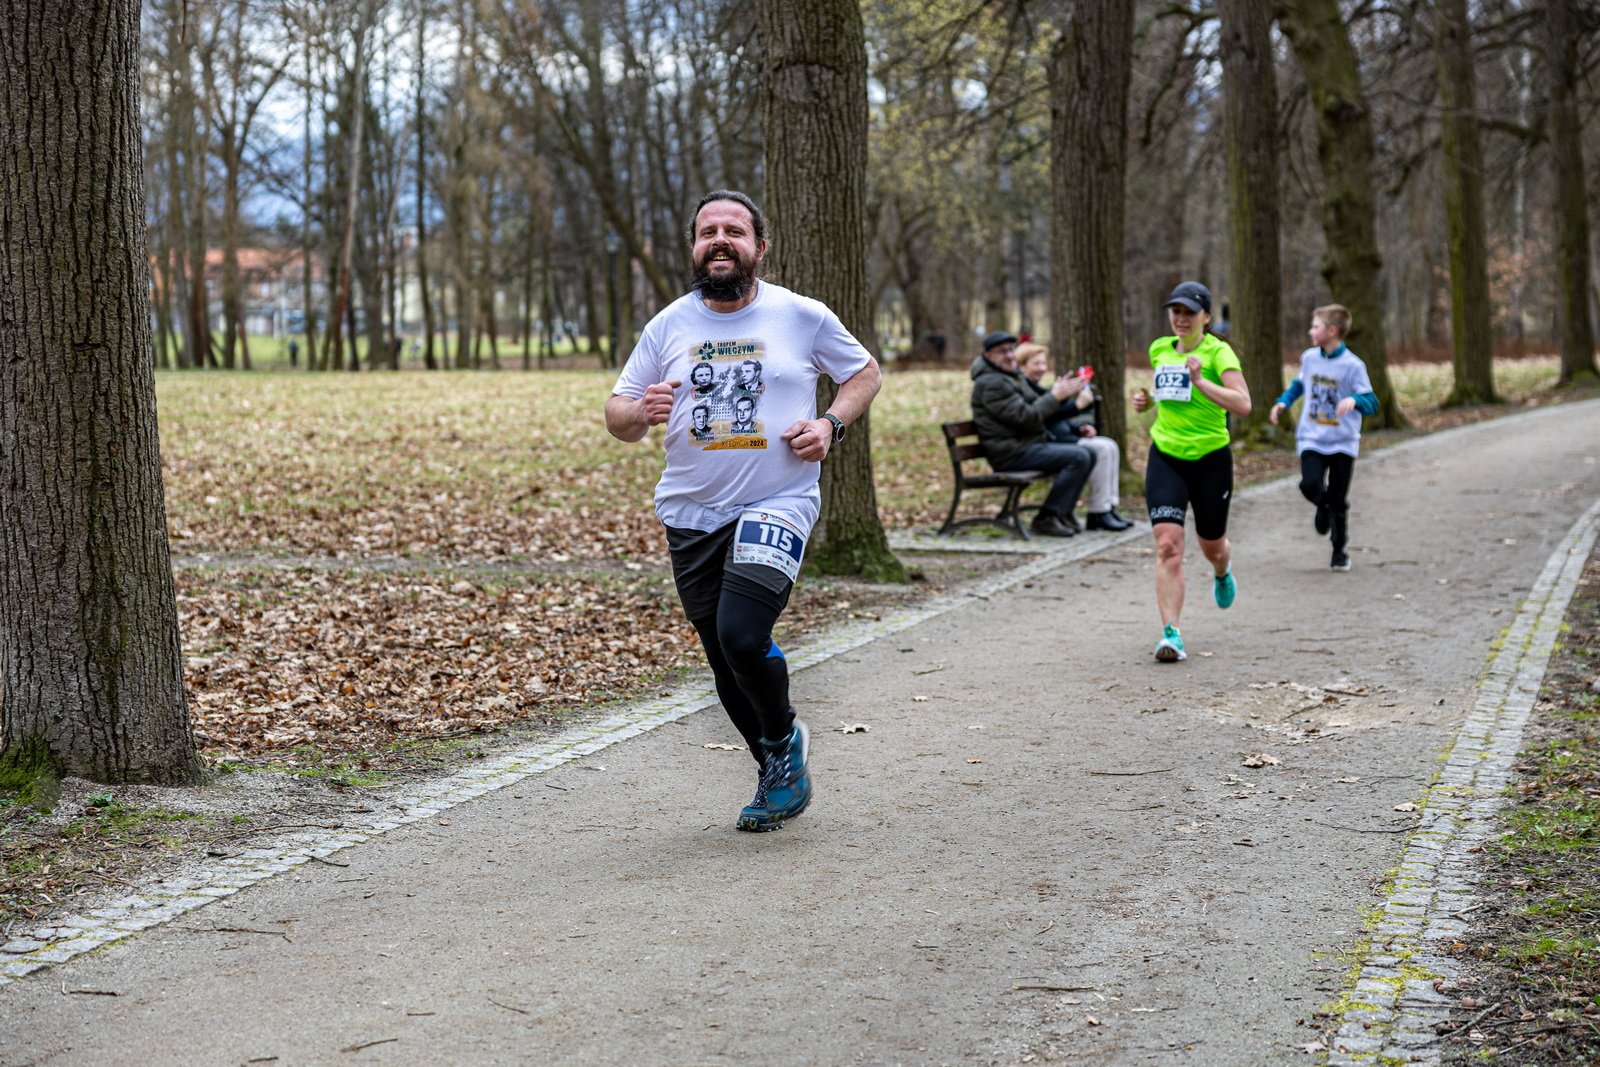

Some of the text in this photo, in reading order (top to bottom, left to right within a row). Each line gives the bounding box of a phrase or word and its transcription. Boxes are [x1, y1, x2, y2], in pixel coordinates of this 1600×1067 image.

[717, 345, 754, 355] WILCZYM
[1158, 373, 1184, 387] 032
[760, 524, 794, 552] 115
